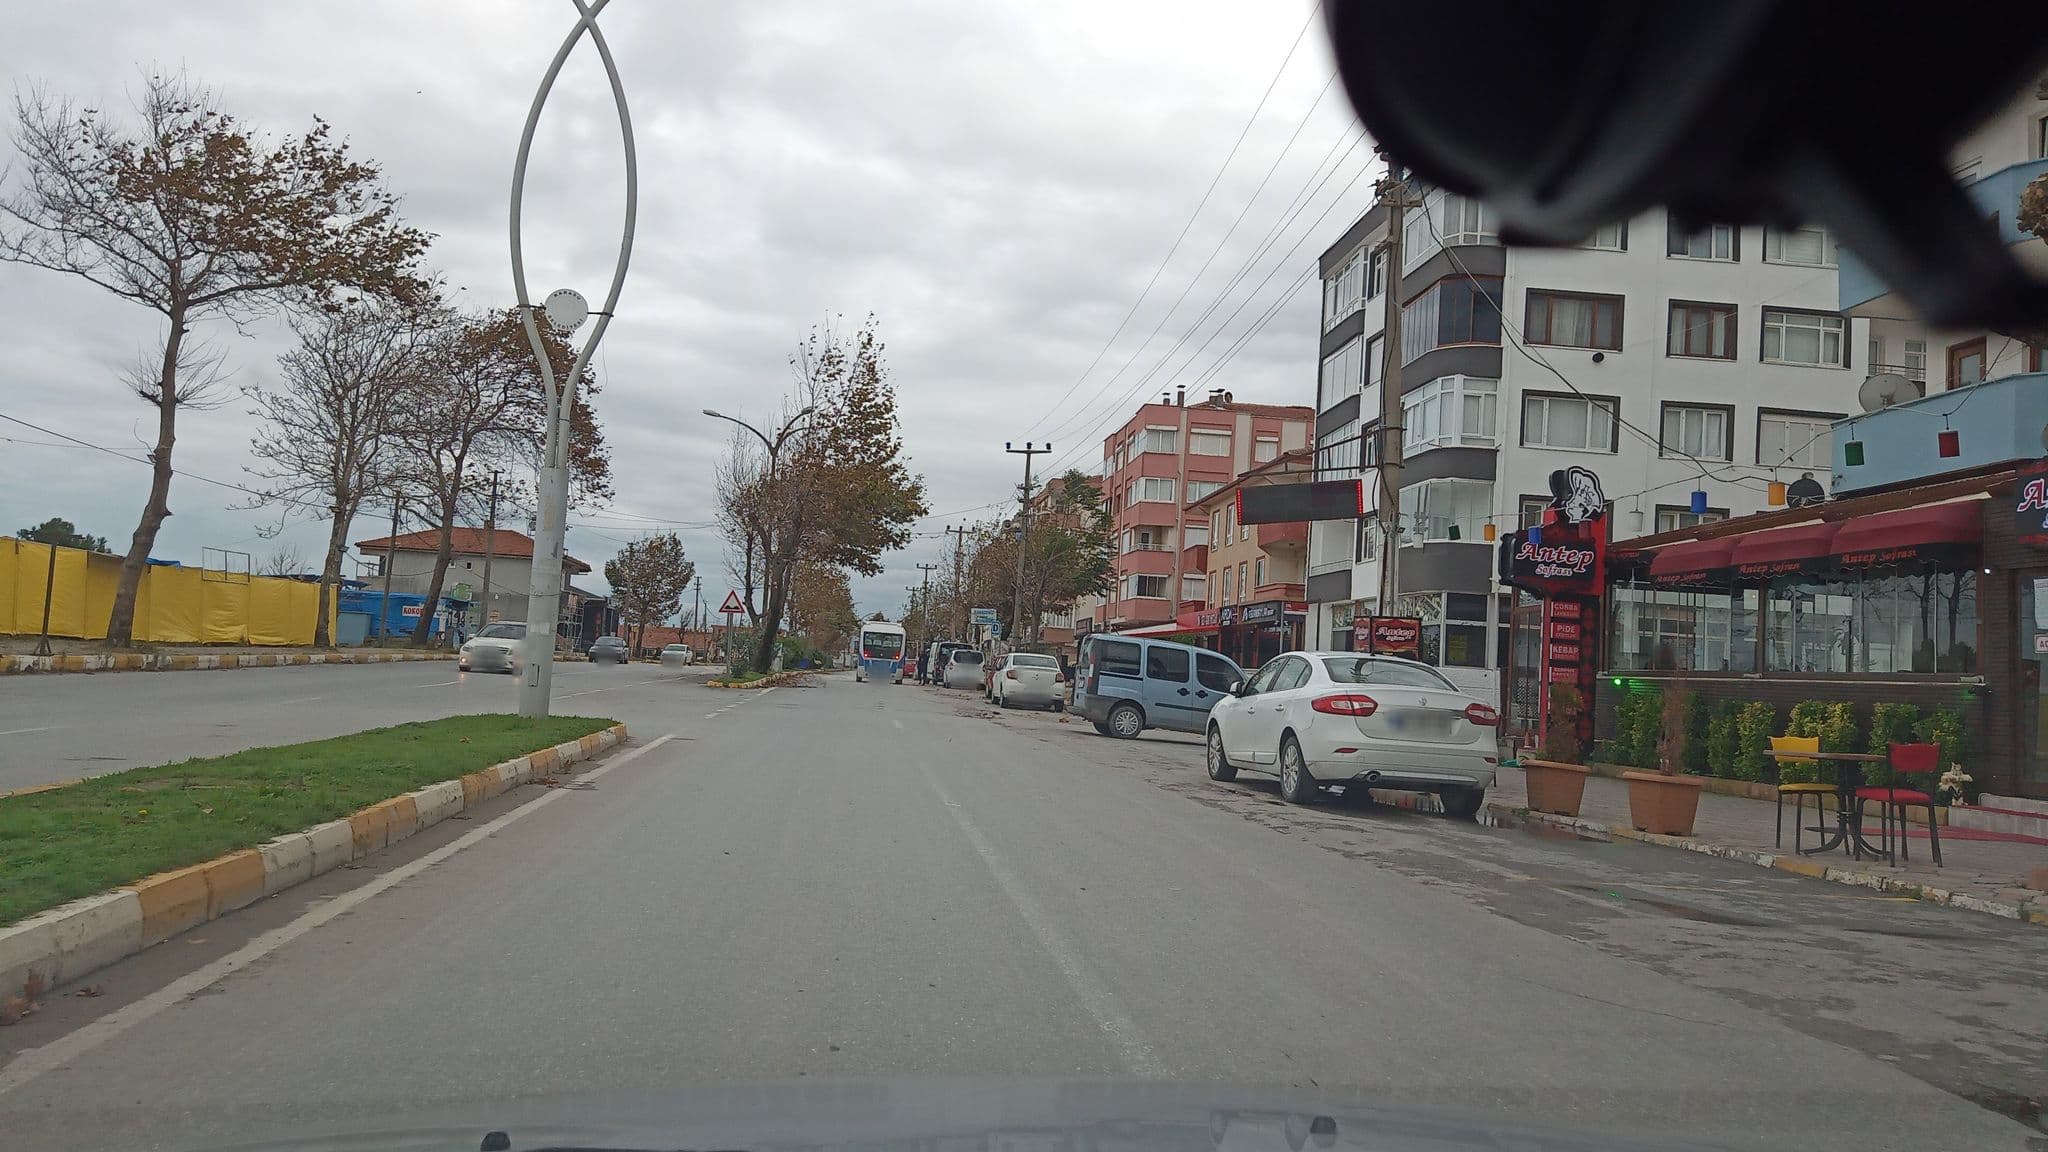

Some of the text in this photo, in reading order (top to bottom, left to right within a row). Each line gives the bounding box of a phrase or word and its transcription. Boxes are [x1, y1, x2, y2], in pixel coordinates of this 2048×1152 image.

[1515, 541, 1594, 572] Antep
[1535, 564, 1573, 577] Sofrası
[1553, 645, 1579, 654] KEBAP
